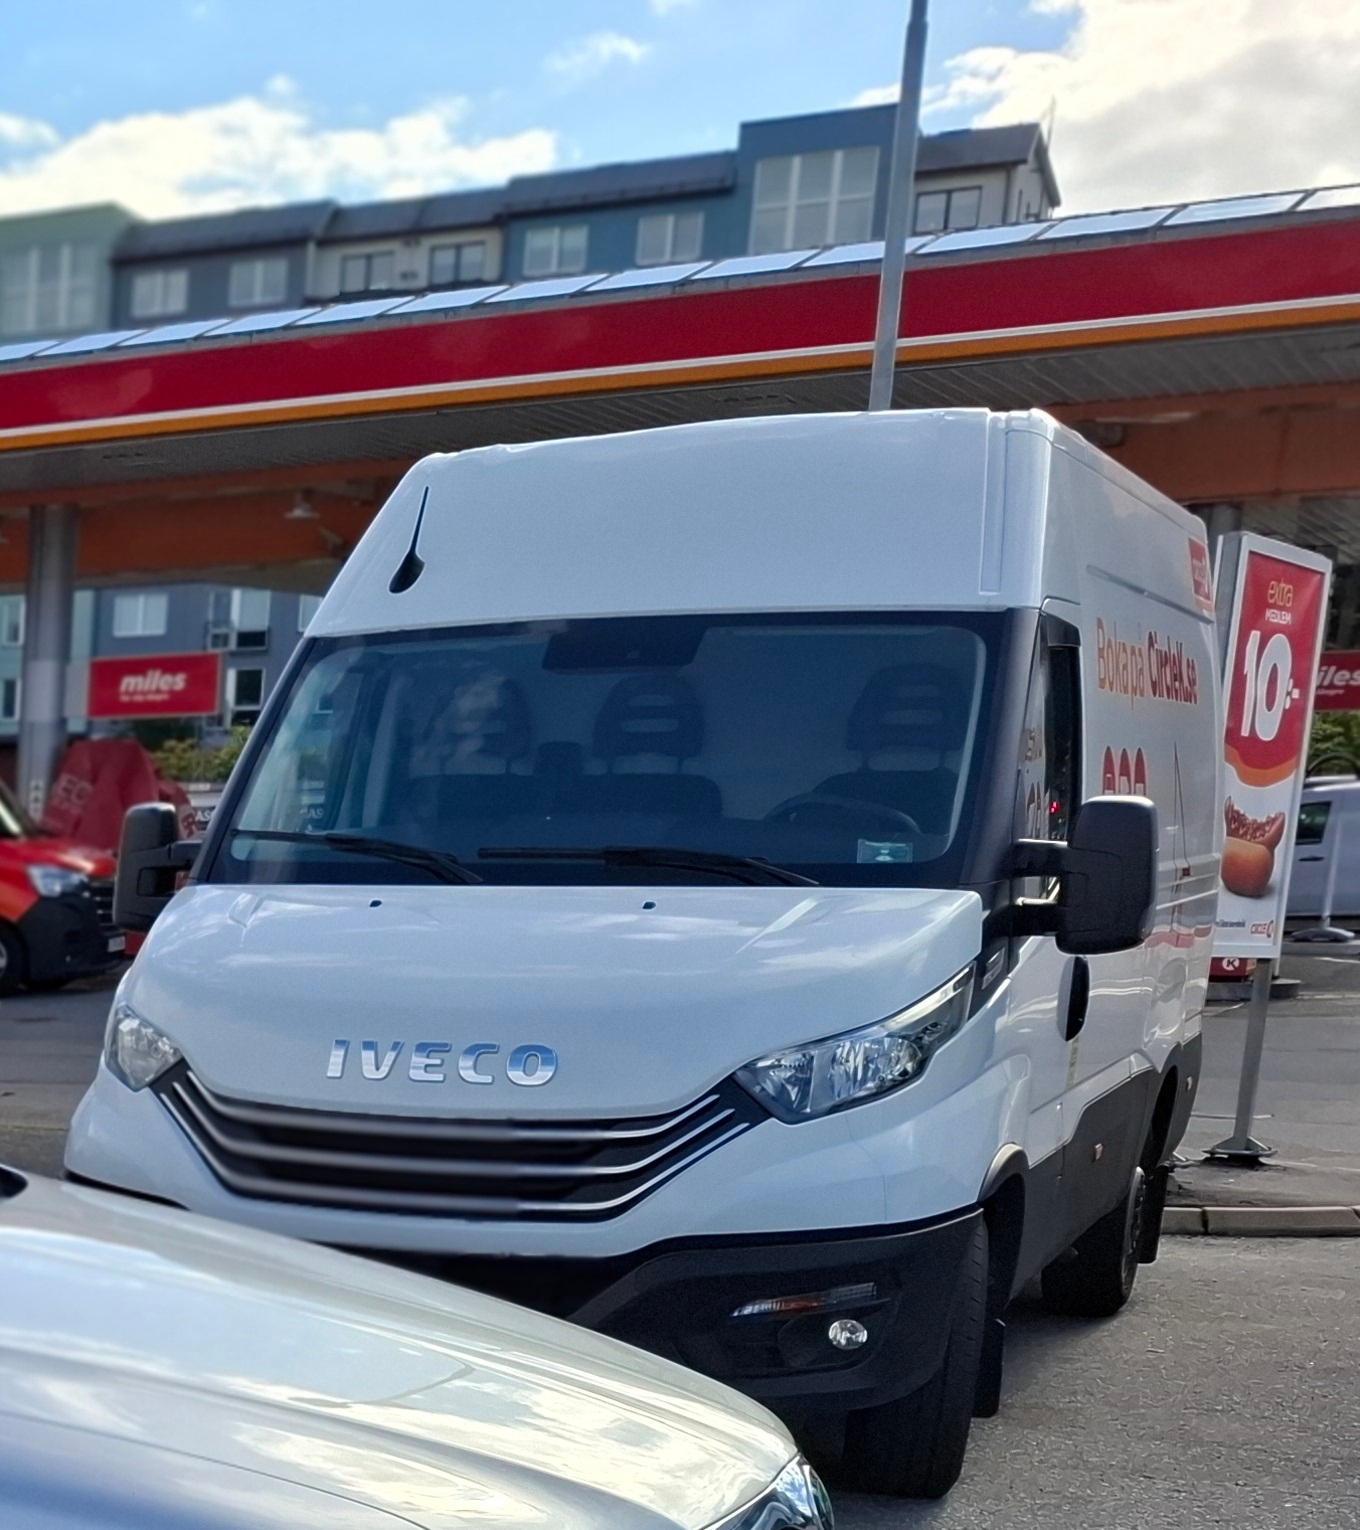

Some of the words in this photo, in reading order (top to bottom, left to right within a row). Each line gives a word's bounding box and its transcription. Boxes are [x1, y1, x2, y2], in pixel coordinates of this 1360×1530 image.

[1268, 578, 1293, 607] extra
[1265, 608, 1291, 625] MEDLEM
[1097, 617, 1129, 695] Boka
[1147, 631, 1197, 704] CircleK.se
[119, 669, 188, 692] miles
[1316, 665, 1360, 686] iles
[326, 1038, 558, 1087] IVECO
